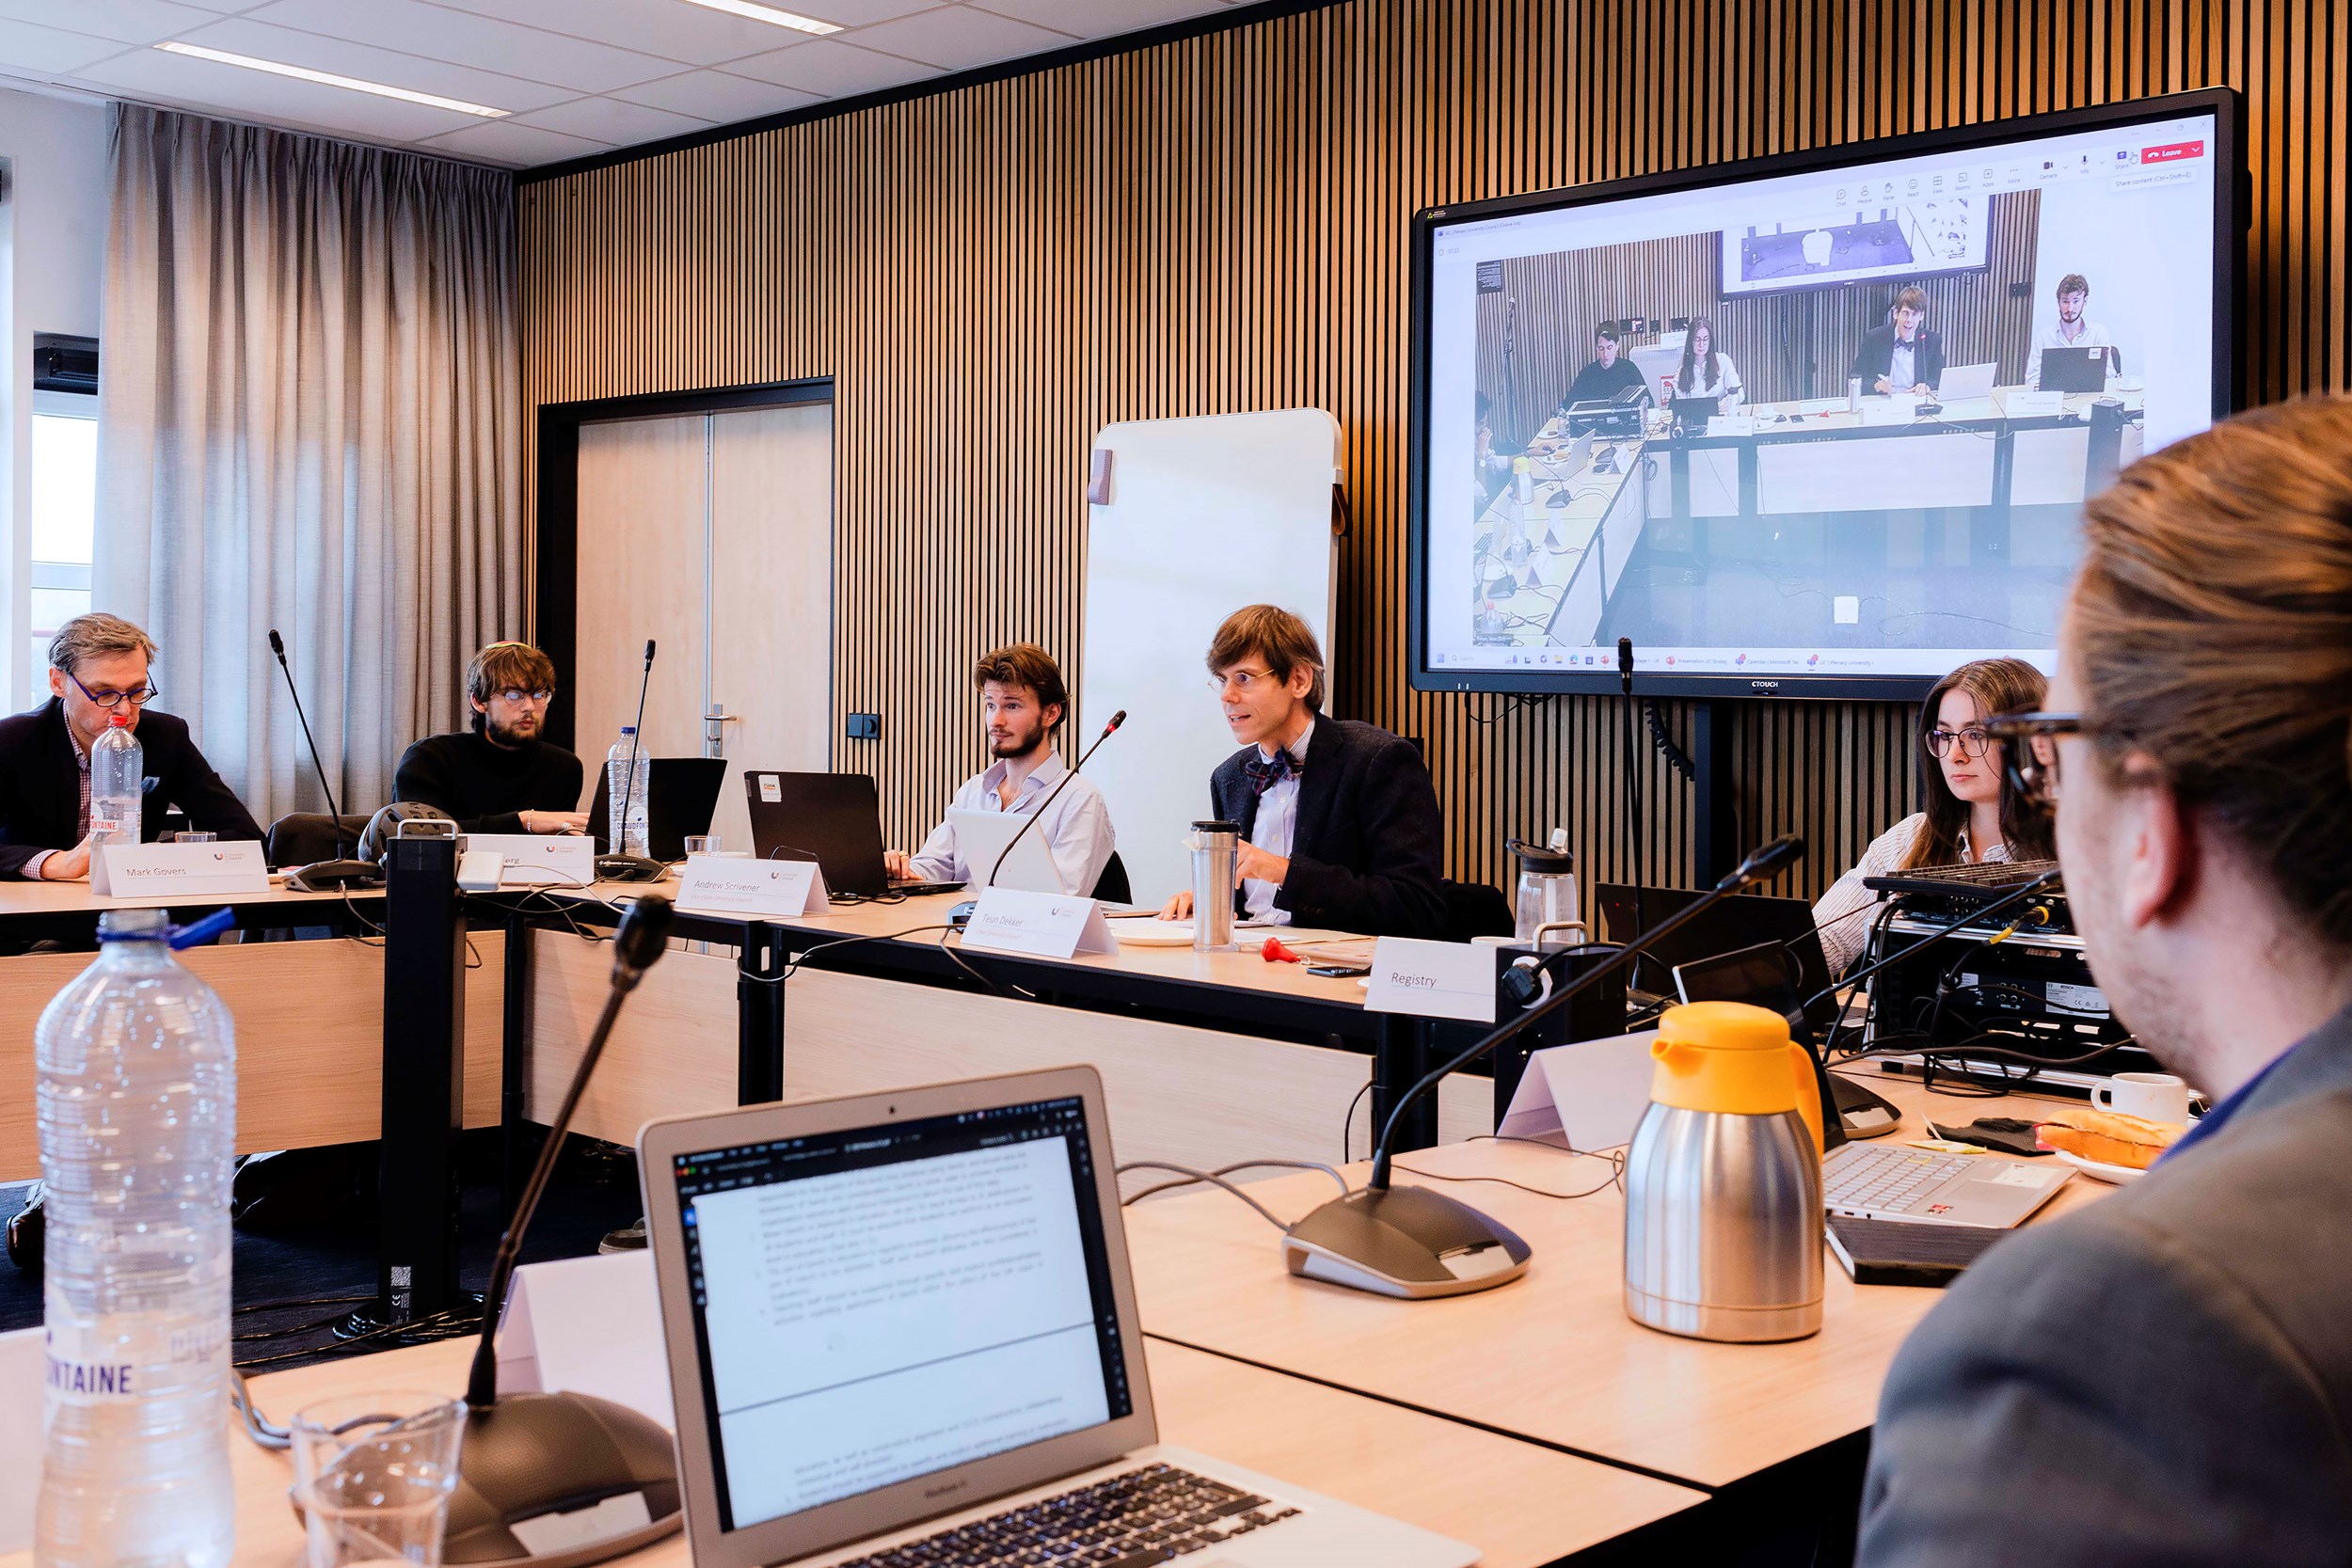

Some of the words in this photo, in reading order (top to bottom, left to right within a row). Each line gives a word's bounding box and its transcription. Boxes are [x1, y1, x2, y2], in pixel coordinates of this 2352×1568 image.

[2162, 149, 2182, 157] Leave
[2132, 177, 2153, 185] content
[126, 867, 151, 877] Mark
[153, 867, 187, 877] Govers
[694, 879, 723, 890] Andrew
[724, 881, 760, 893] Scrivener
[982, 913, 999, 923] Teun
[999, 915, 1024, 927] Dekker
[1391, 972, 1437, 989] Registry
